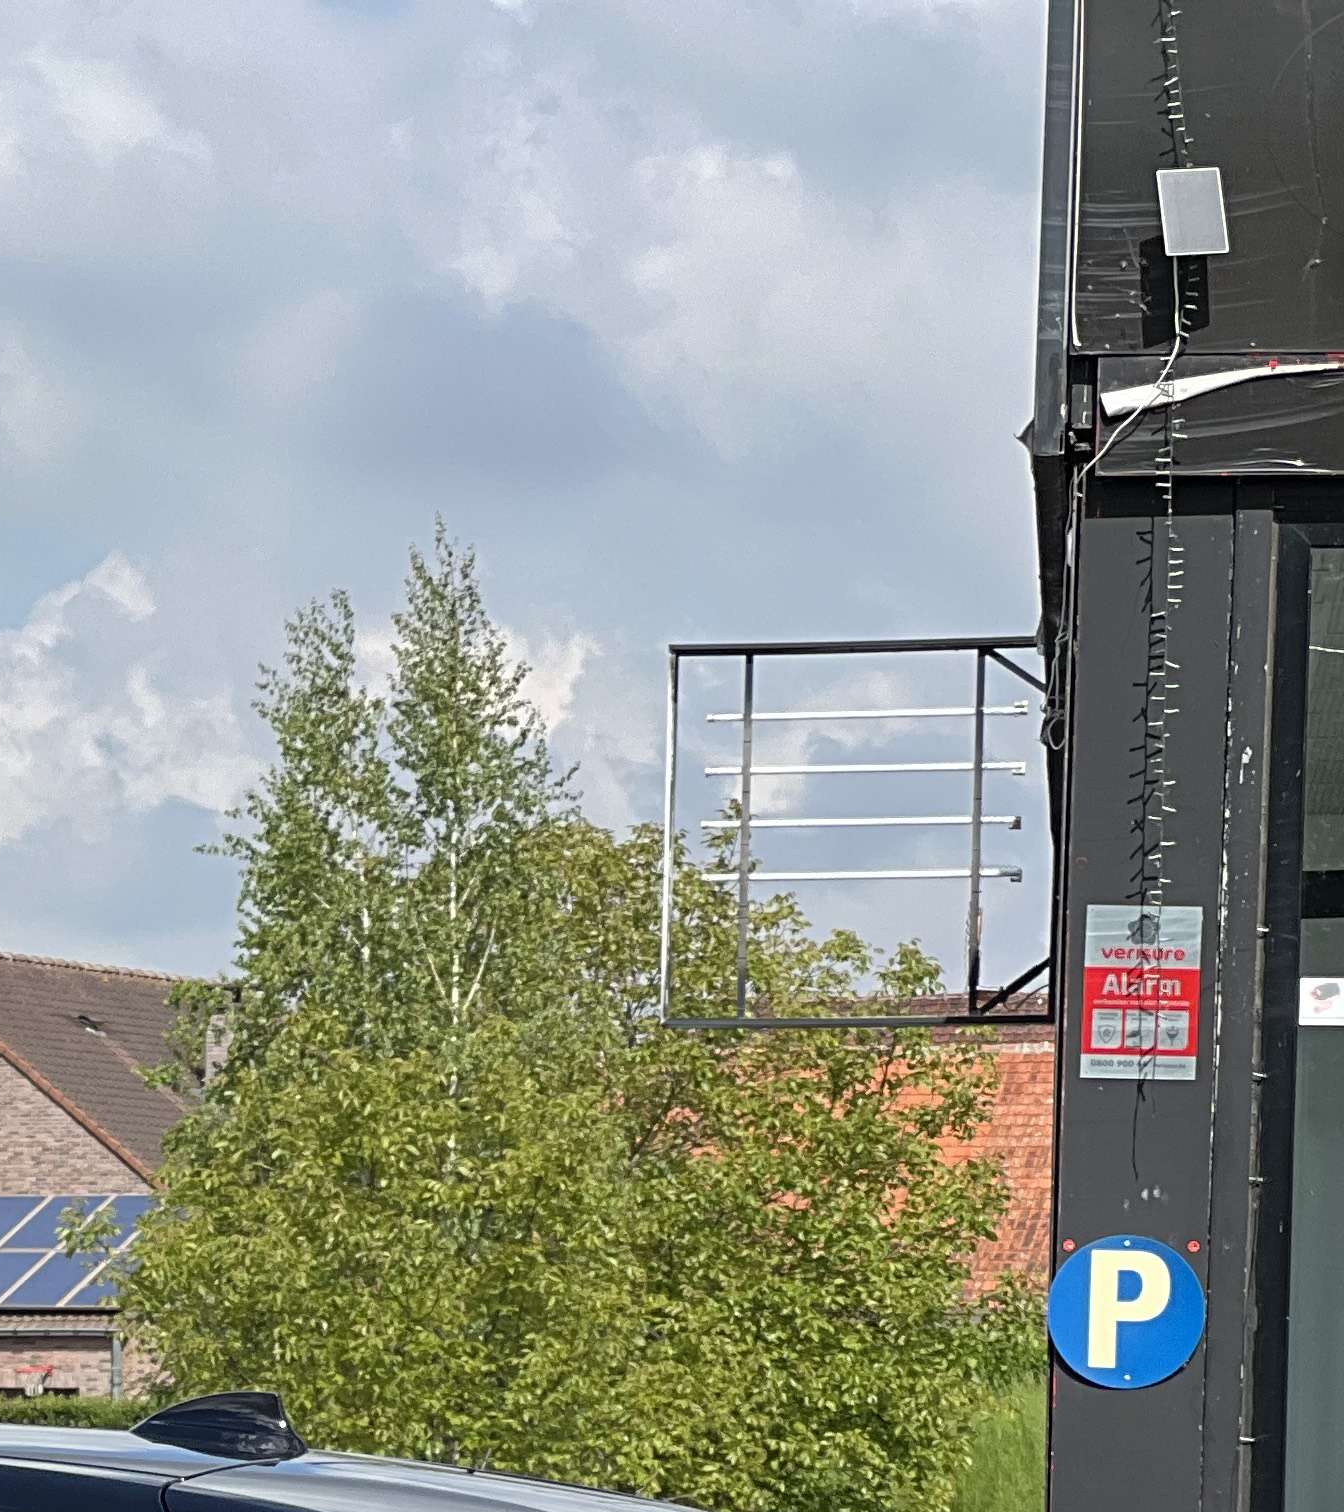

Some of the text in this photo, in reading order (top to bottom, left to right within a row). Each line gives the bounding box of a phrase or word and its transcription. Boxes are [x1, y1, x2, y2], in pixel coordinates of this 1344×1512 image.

[1101, 946, 1186, 961] verisure
[1101, 971, 1182, 997] Alarm
[1086, 1249, 1172, 1369] P
